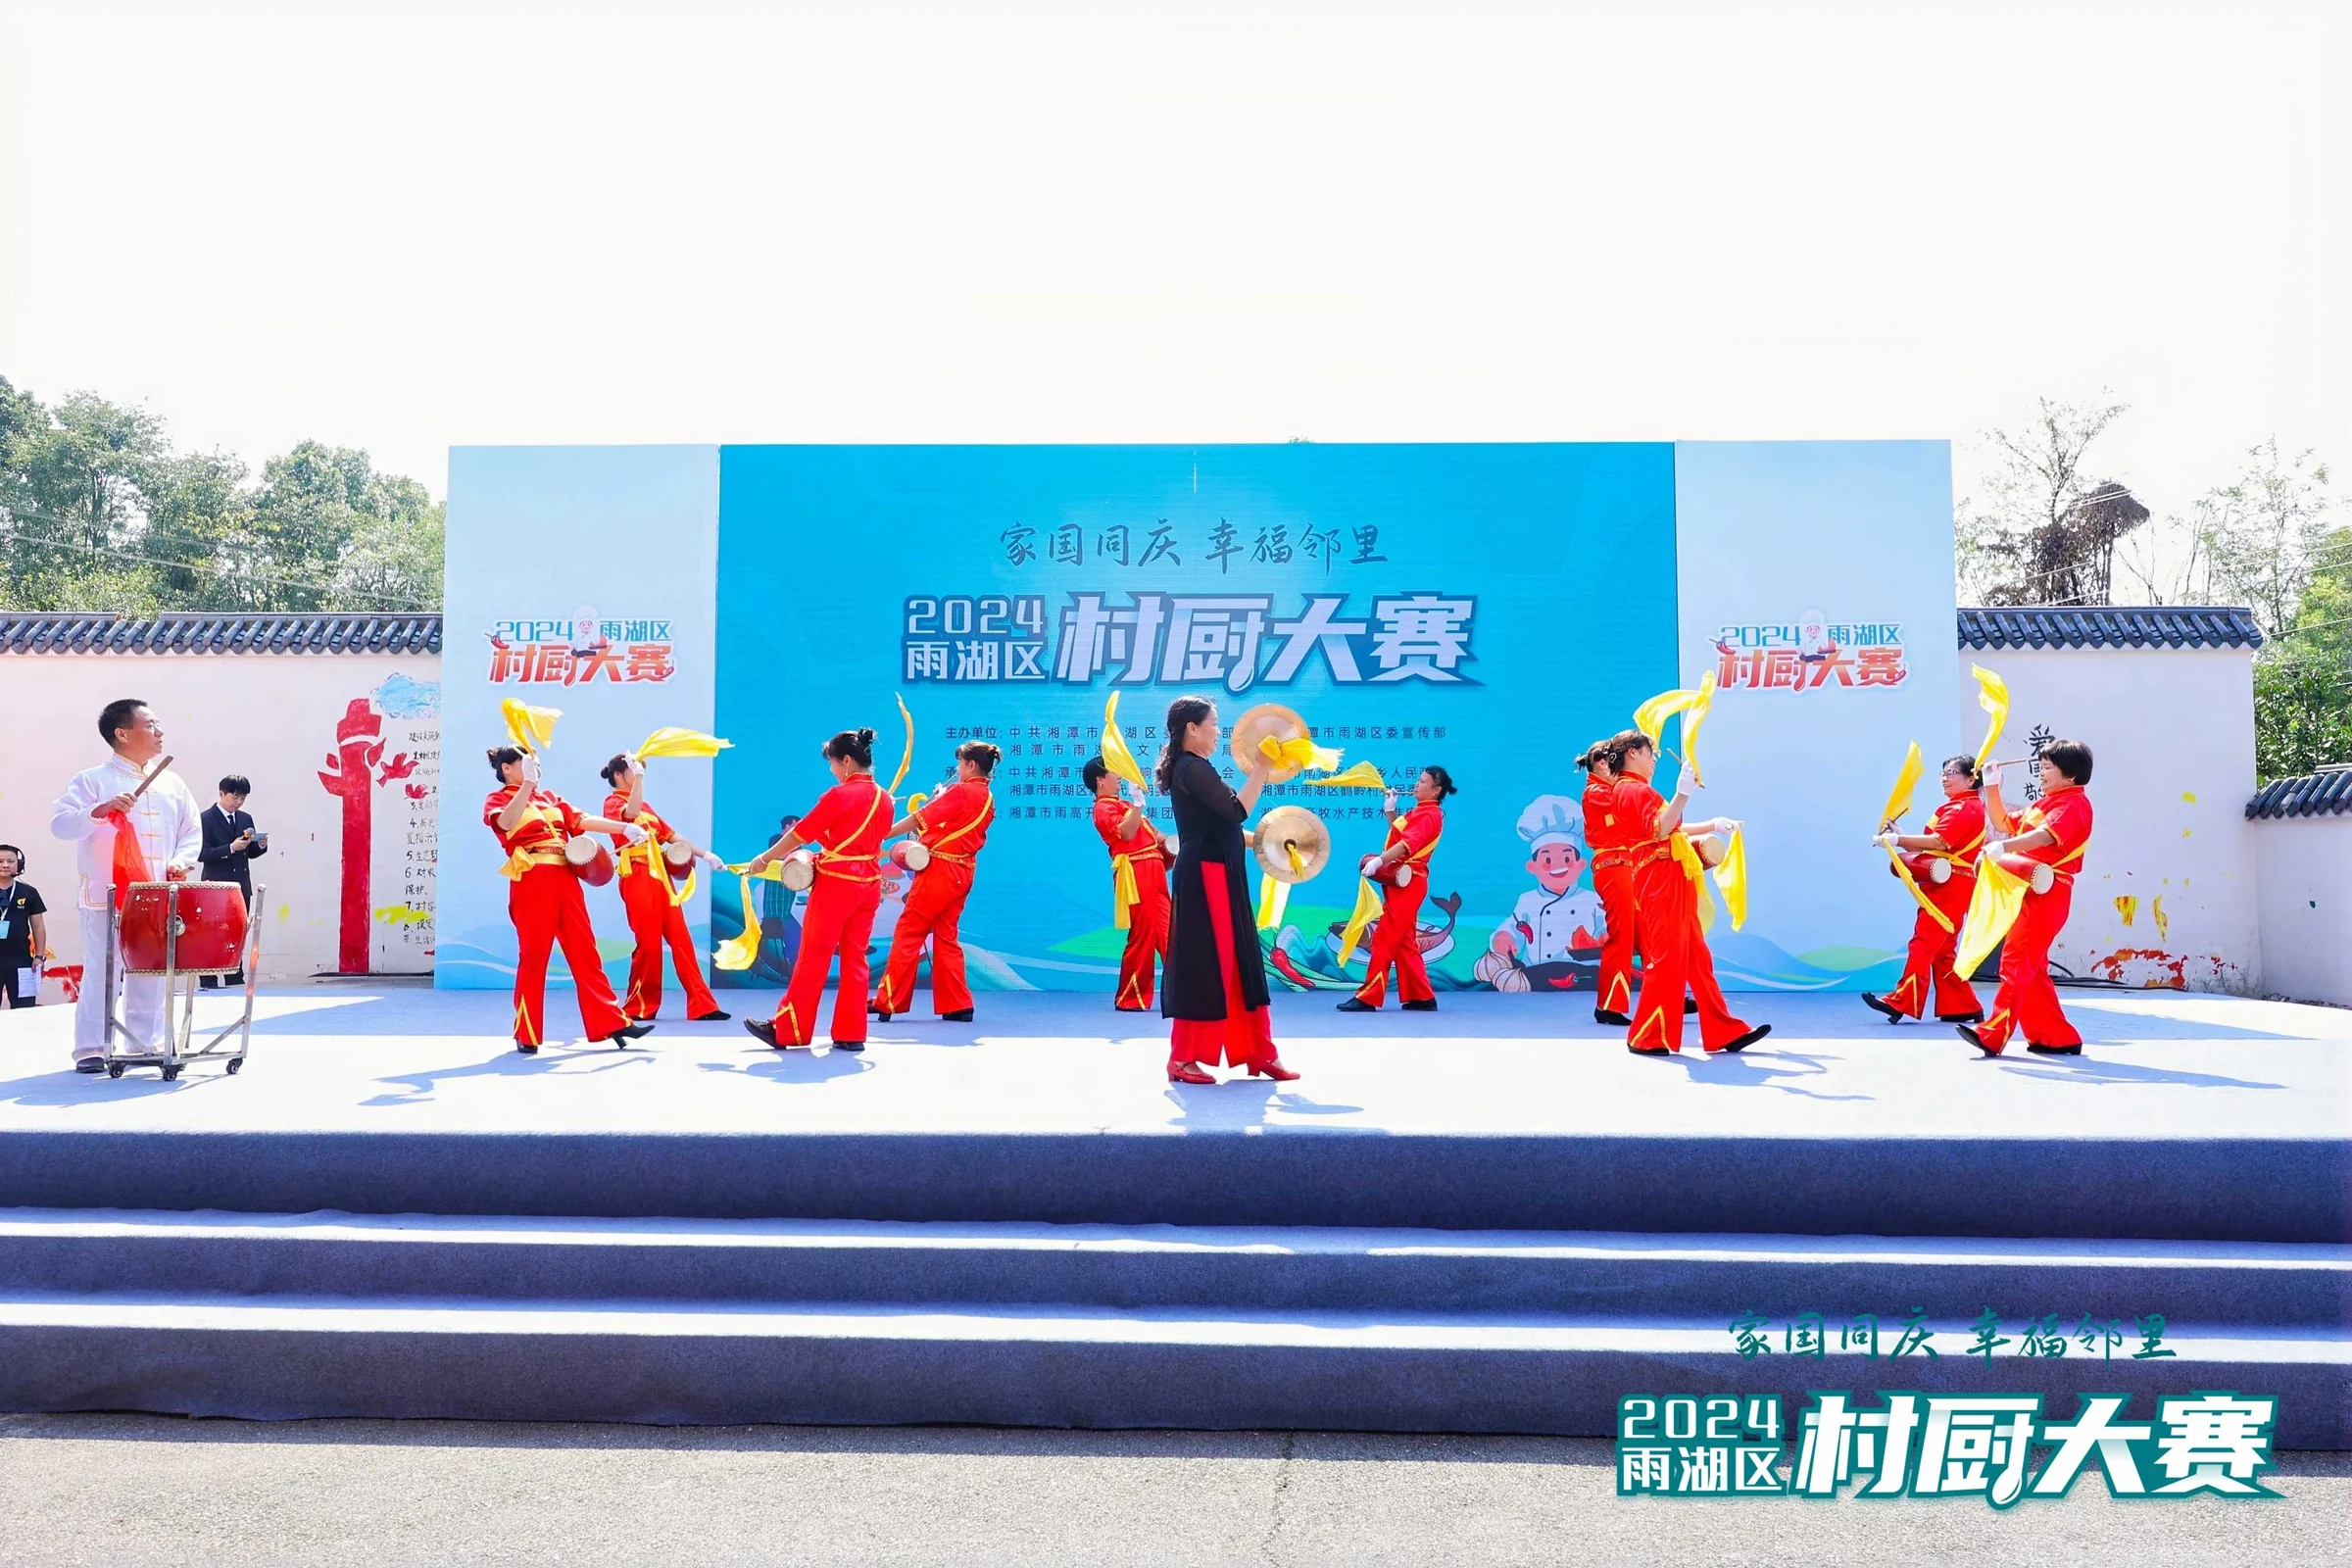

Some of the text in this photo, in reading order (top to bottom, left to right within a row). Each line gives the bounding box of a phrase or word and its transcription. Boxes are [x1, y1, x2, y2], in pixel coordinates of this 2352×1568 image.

[1000, 516, 1389, 576] 家国同庆 幸福邻里
[496, 620, 672, 642] 2024 雨湖区
[907, 599, 1044, 634] 2024
[1721, 624, 1902, 647] 2024 雨湖区
[906, 641, 1045, 680] 雨湖区
[1057, 594, 1473, 692] 村厨大赛
[489, 644, 672, 686] 村厨大赛
[1717, 648, 1903, 691] 村厨大赛
